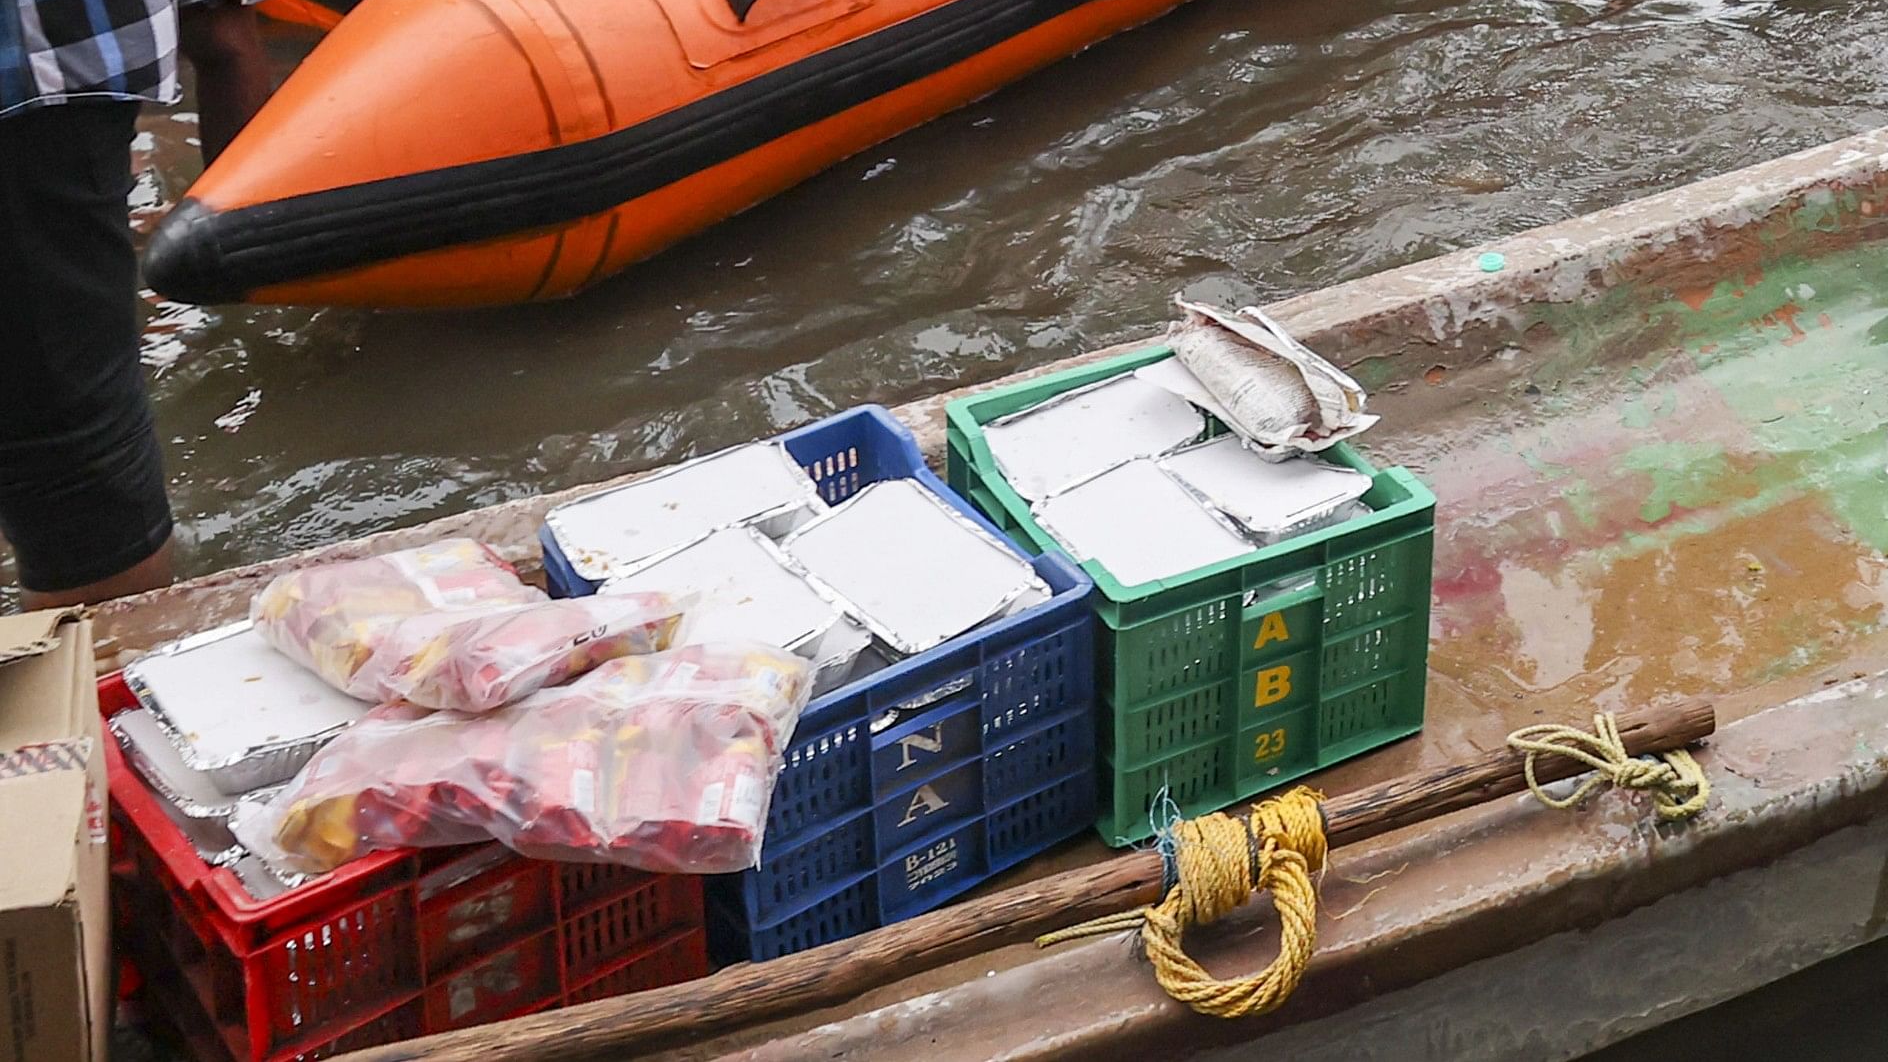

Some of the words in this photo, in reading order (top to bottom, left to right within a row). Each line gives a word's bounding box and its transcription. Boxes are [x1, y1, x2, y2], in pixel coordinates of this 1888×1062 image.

[1254, 611, 1289, 649] A
[1254, 665, 1292, 708] B
[896, 720, 944, 771] N
[1255, 728, 1286, 759] 23
[897, 784, 949, 827] A
[904, 837, 956, 872] B-121
